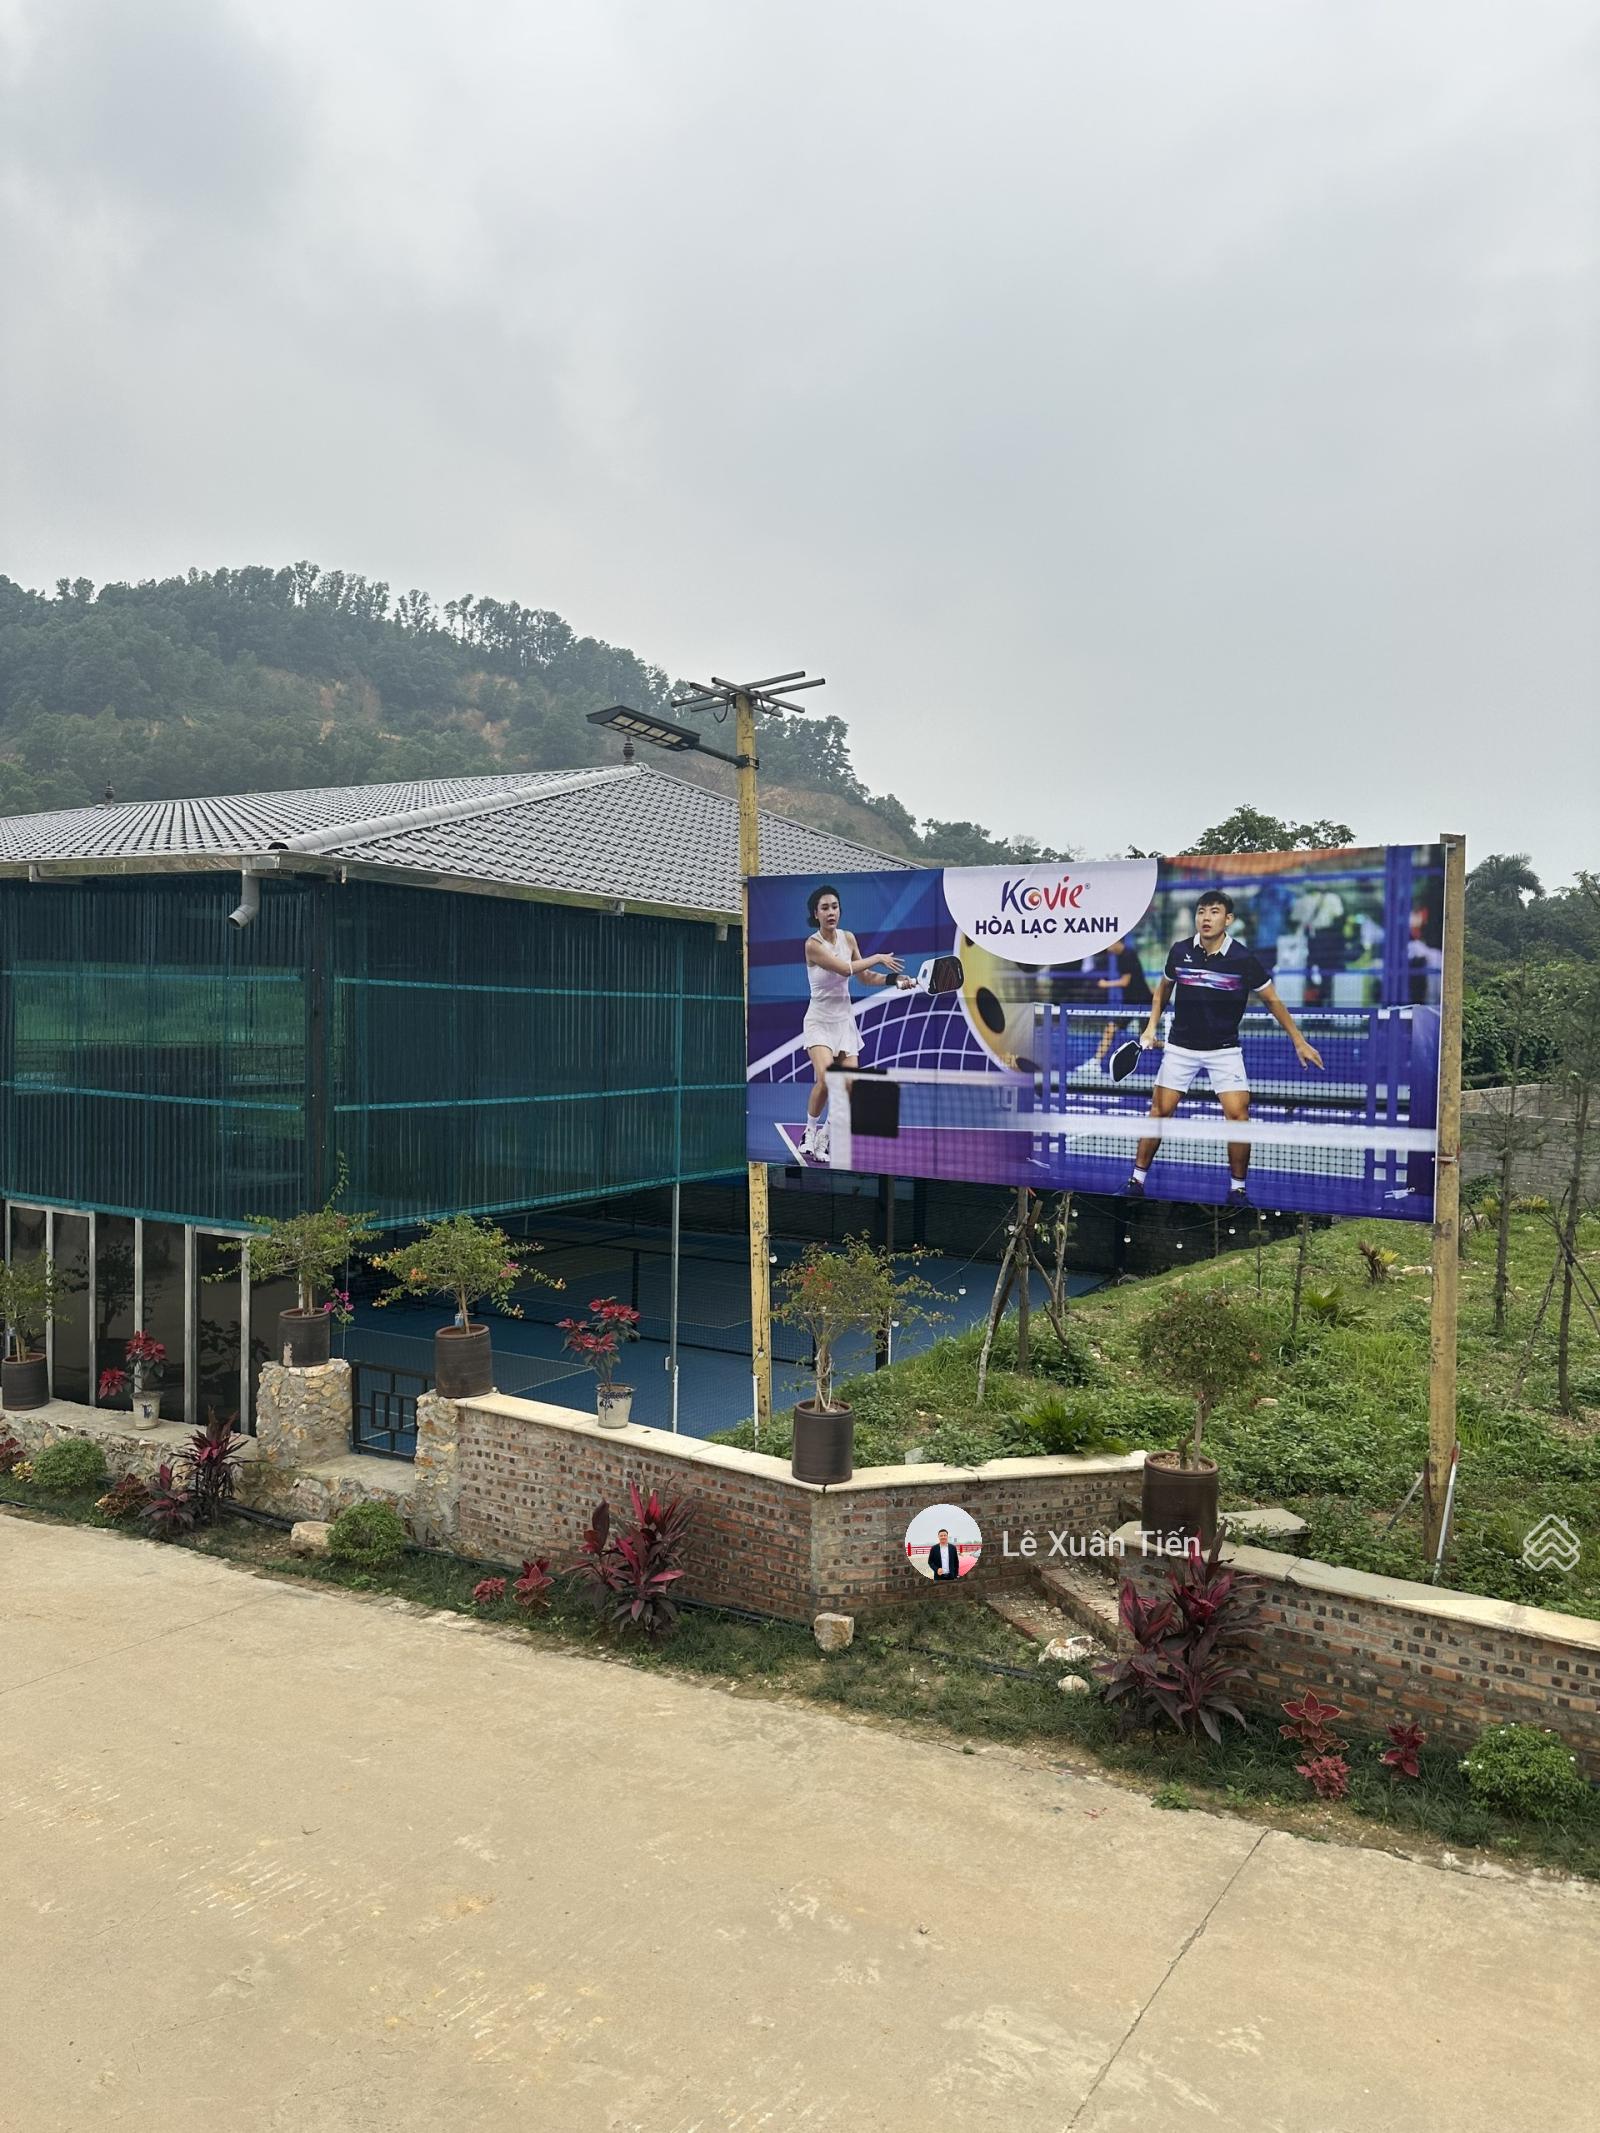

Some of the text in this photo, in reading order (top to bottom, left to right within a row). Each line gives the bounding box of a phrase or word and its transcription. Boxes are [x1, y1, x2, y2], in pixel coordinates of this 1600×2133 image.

[975, 915, 1119, 938] HÒA LẠC XANH
